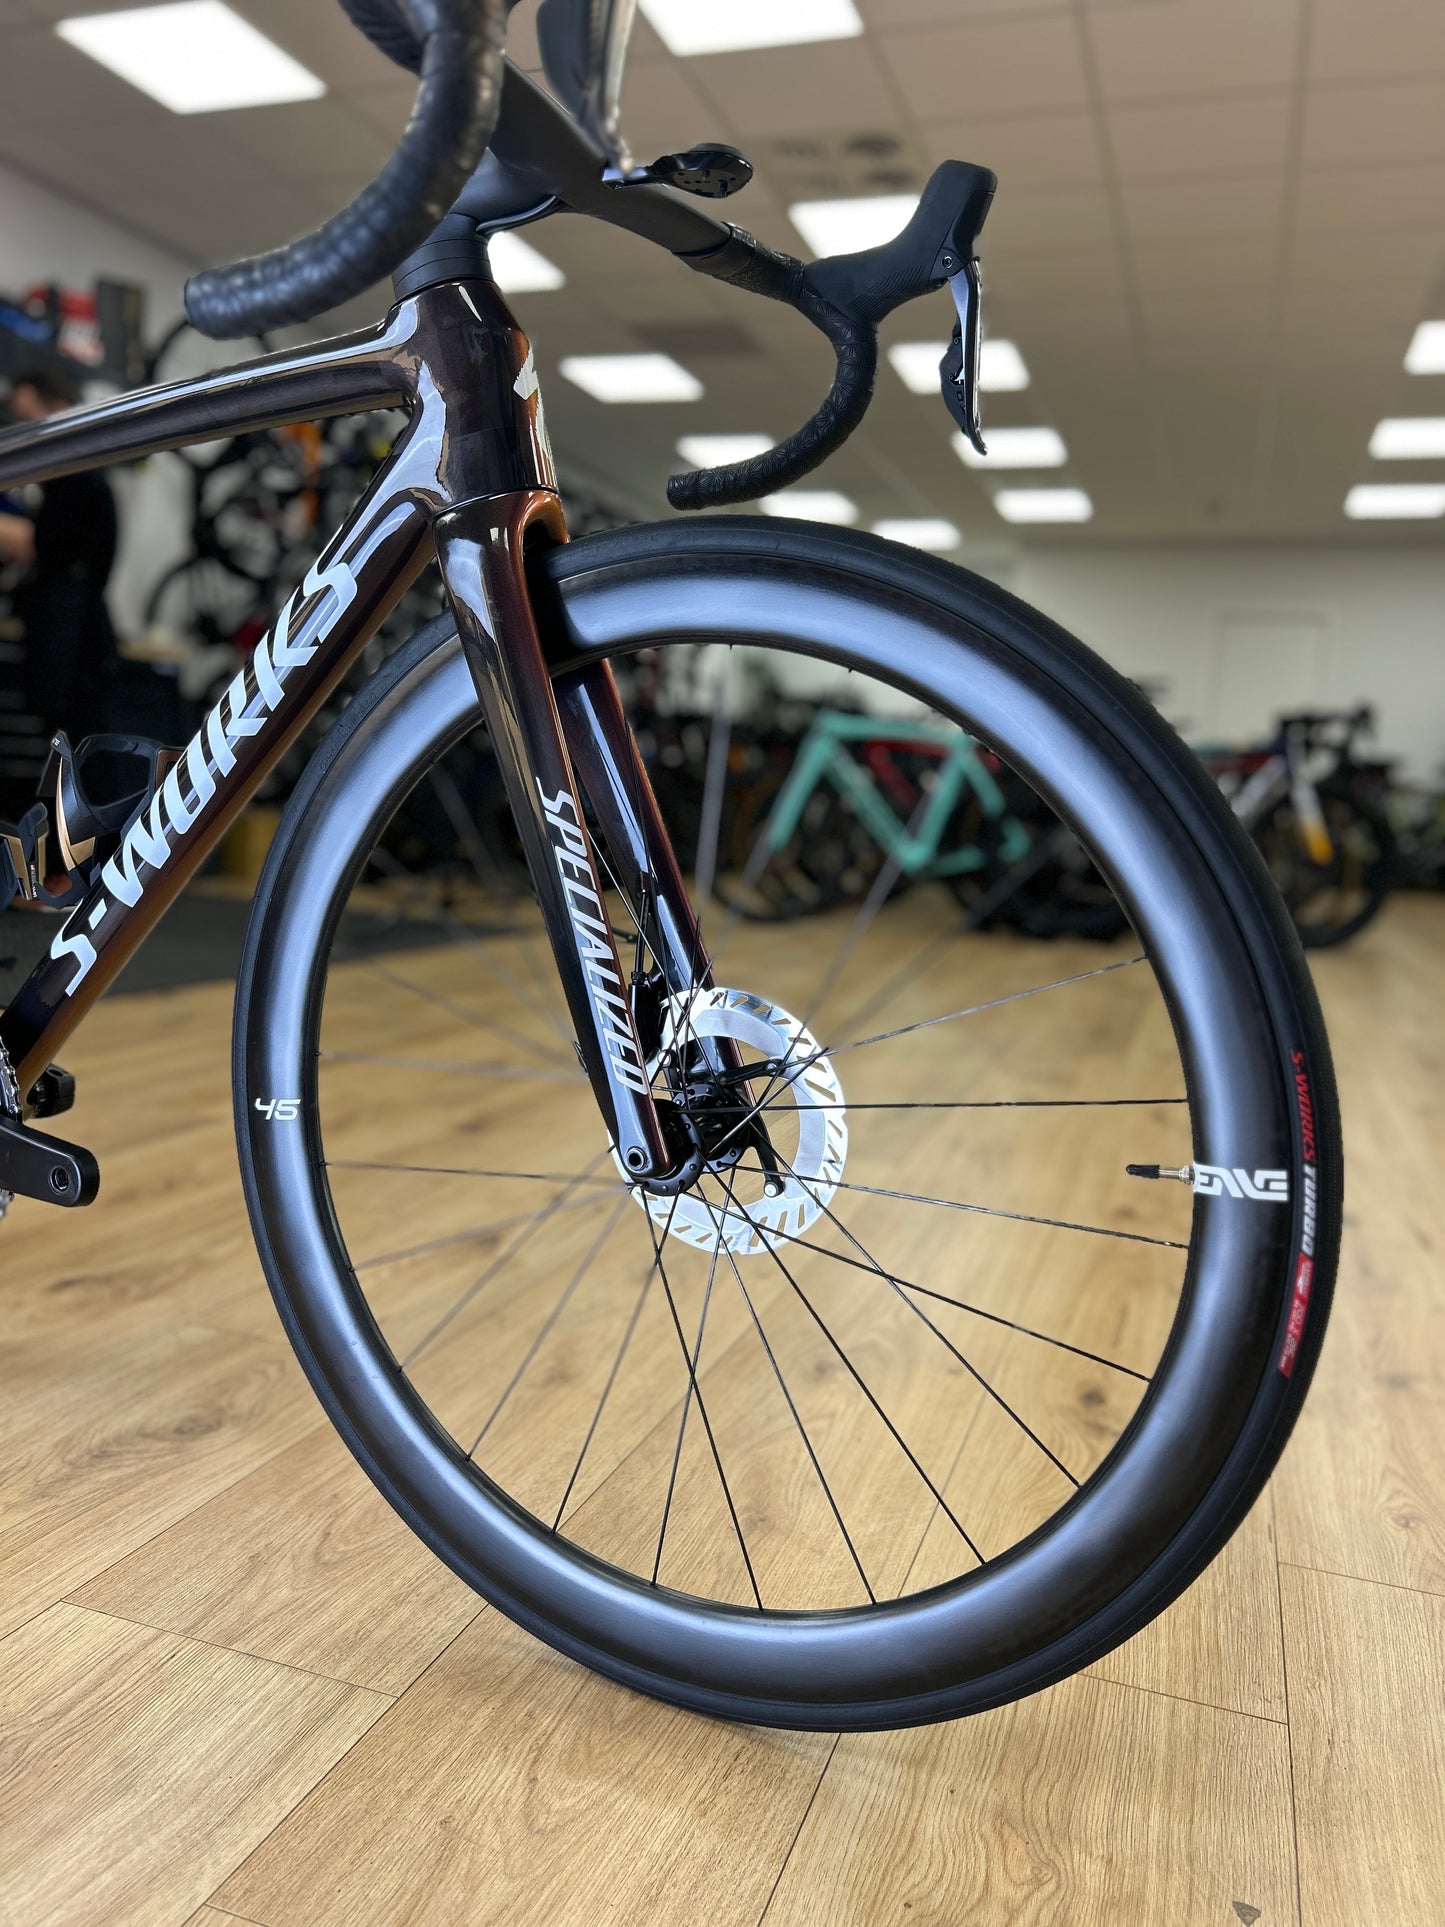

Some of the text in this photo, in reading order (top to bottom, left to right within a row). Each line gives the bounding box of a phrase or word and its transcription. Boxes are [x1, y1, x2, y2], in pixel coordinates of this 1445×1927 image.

[50, 524, 358, 996] S-WORKS
[536, 776, 648, 1095] SPECIALIZED
[255, 1097, 301, 1120] 45
[1290, 1048, 1315, 1162] S-WORKS
[1193, 1162, 1288, 1201] ENVE
[1302, 1163, 1317, 1257] TURBO
